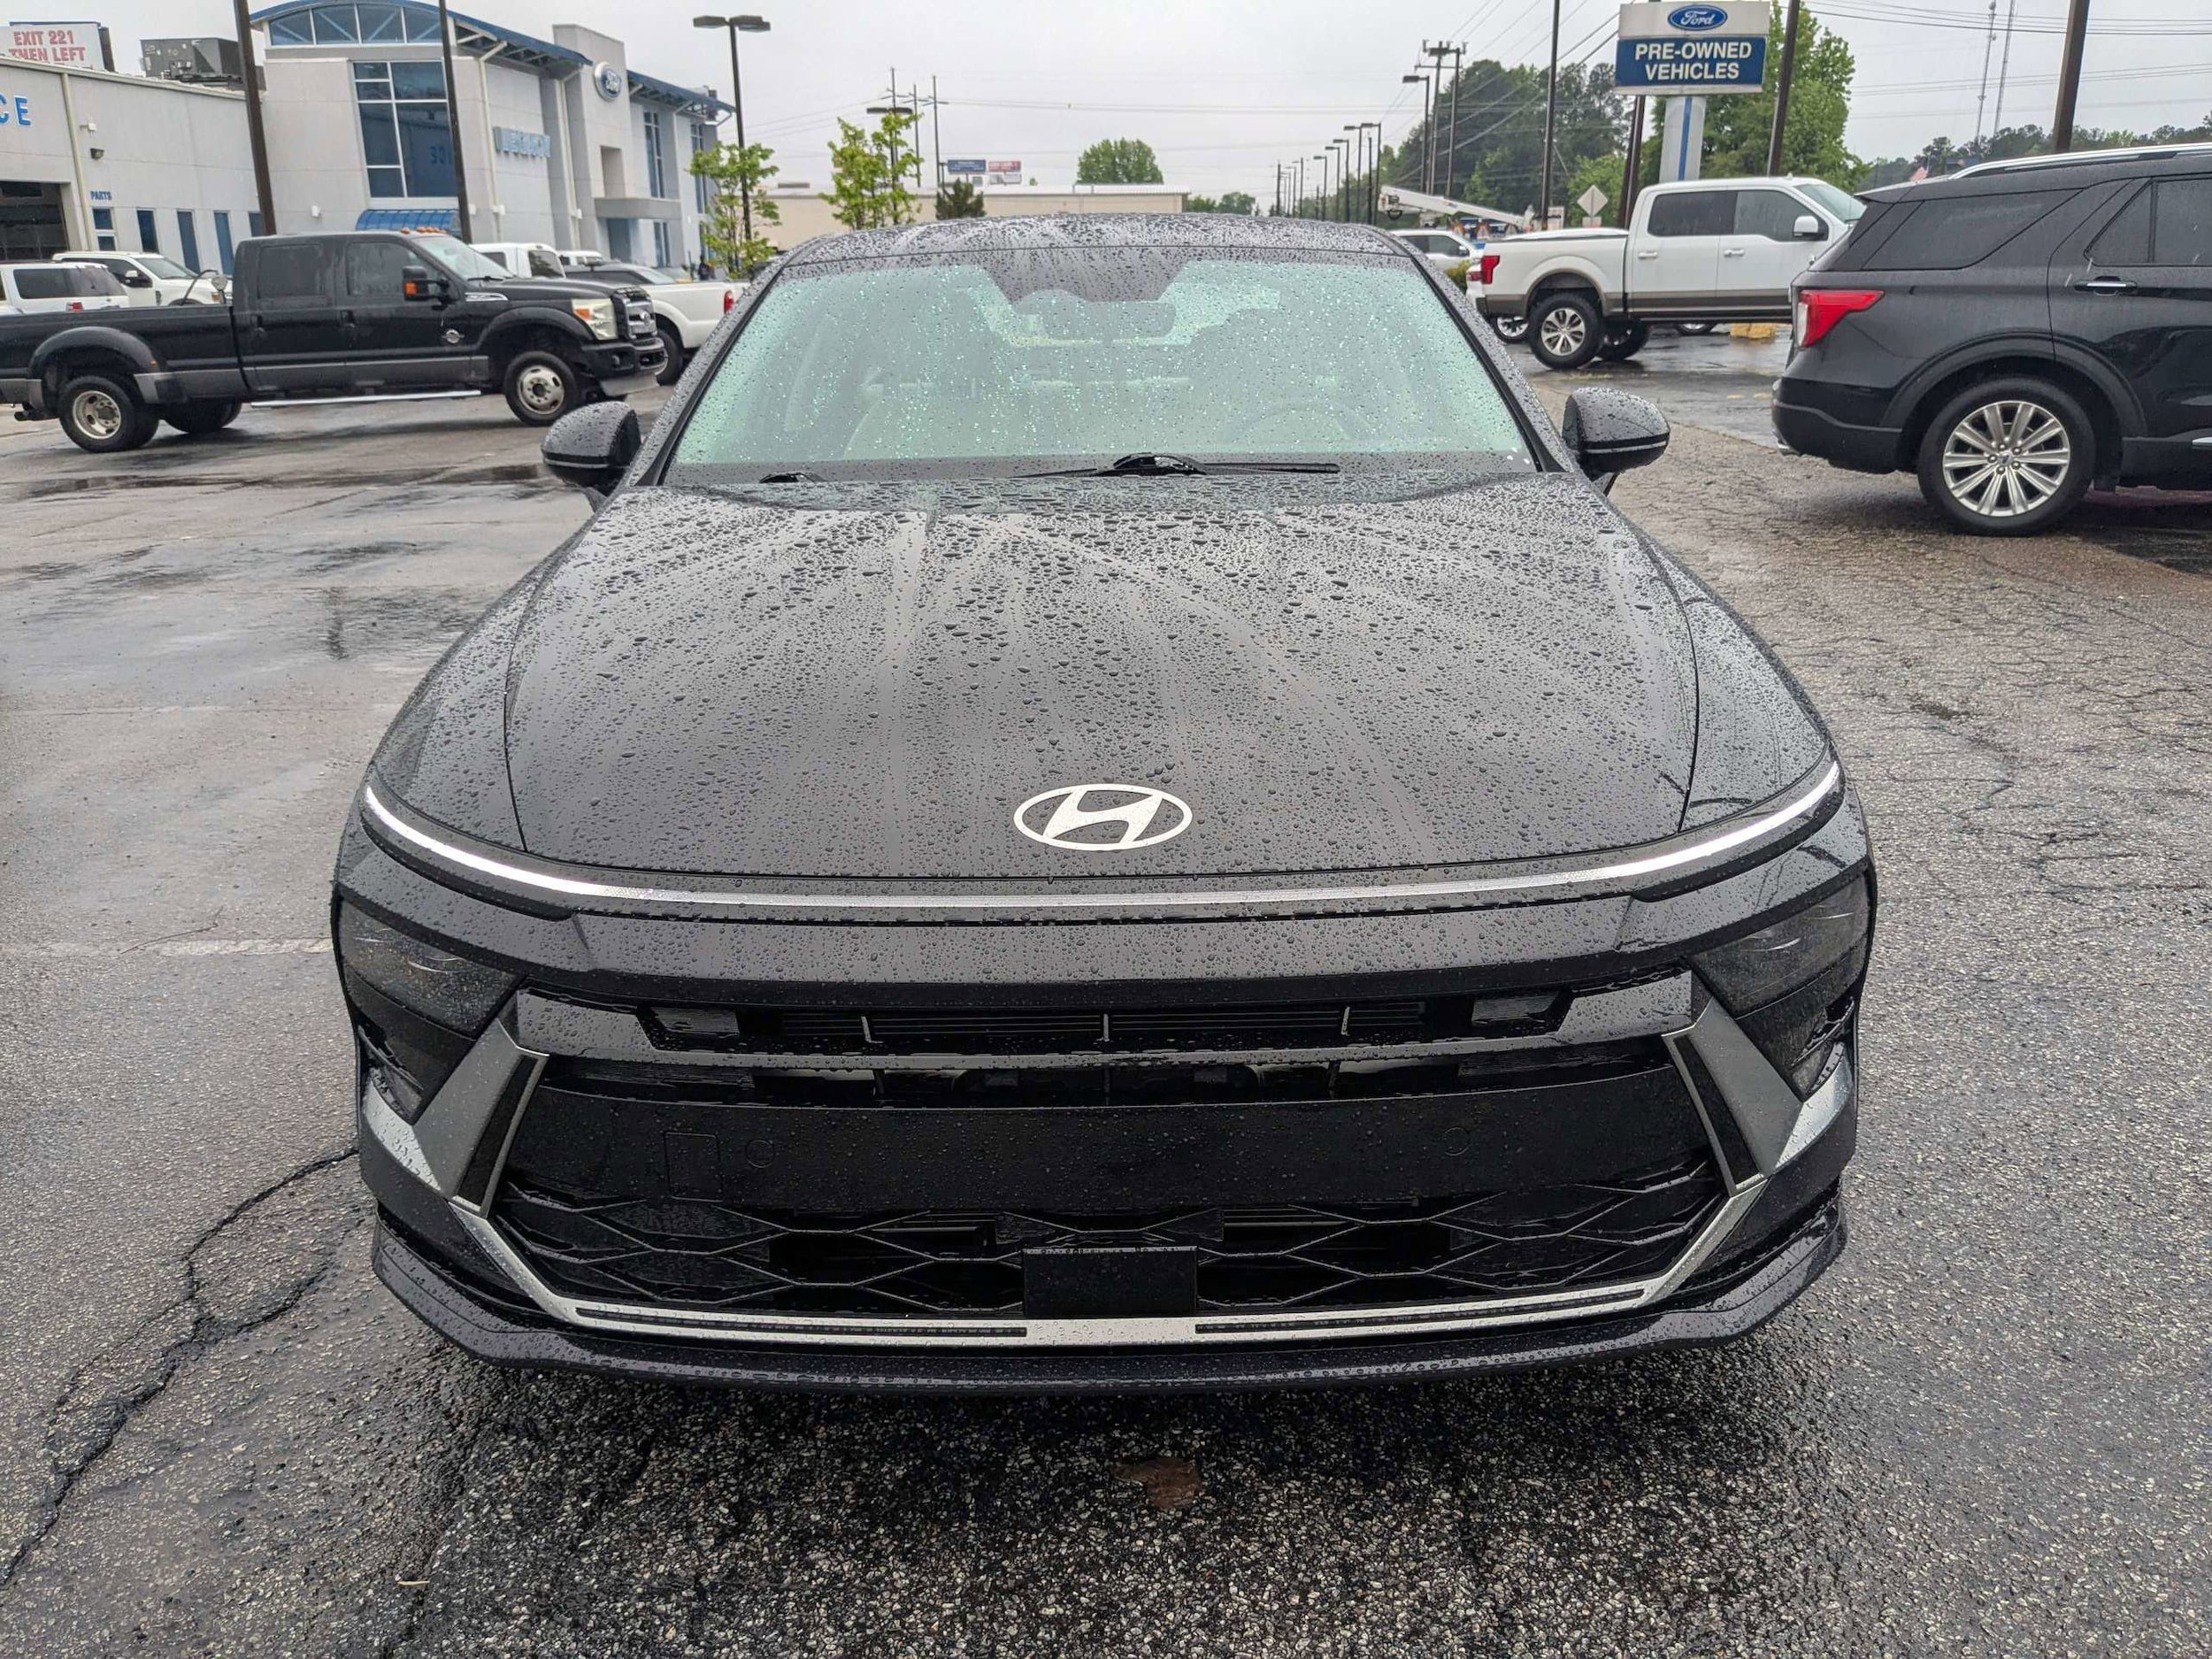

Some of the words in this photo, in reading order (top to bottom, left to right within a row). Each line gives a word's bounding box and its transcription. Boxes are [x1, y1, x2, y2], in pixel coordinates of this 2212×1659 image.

[1680, 10, 1717, 26] Ford
[13, 31, 43, 45] EXIT
[48, 30, 74, 44] 221
[9, 48, 48, 61] THEN
[53, 47, 86, 61] LEFT
[1634, 42, 1752, 60] PRE-OWNED
[1645, 63, 1740, 81] VEHICLES
[89, 189, 112, 201] PARTS
